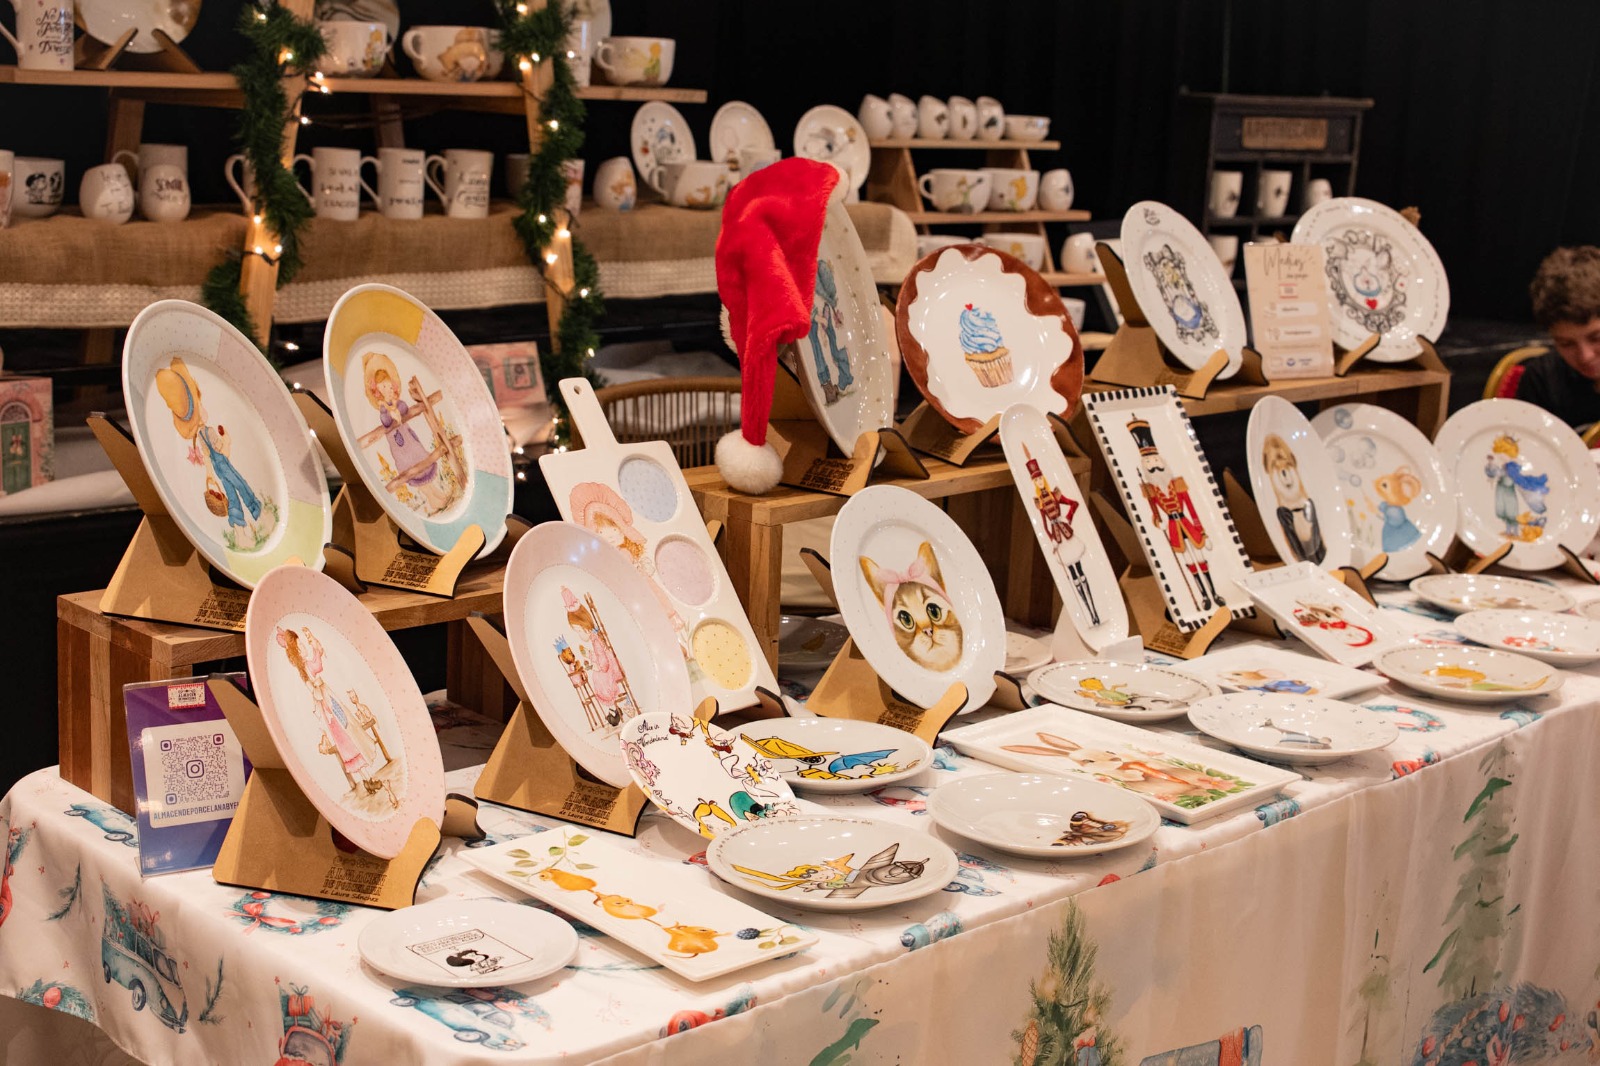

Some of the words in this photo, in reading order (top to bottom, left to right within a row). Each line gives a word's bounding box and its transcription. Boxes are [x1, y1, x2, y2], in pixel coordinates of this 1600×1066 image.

[565, 791, 617, 812] ALMACEN
[325, 866, 387, 886] ALMACEN
[331, 889, 350, 897] Laura
